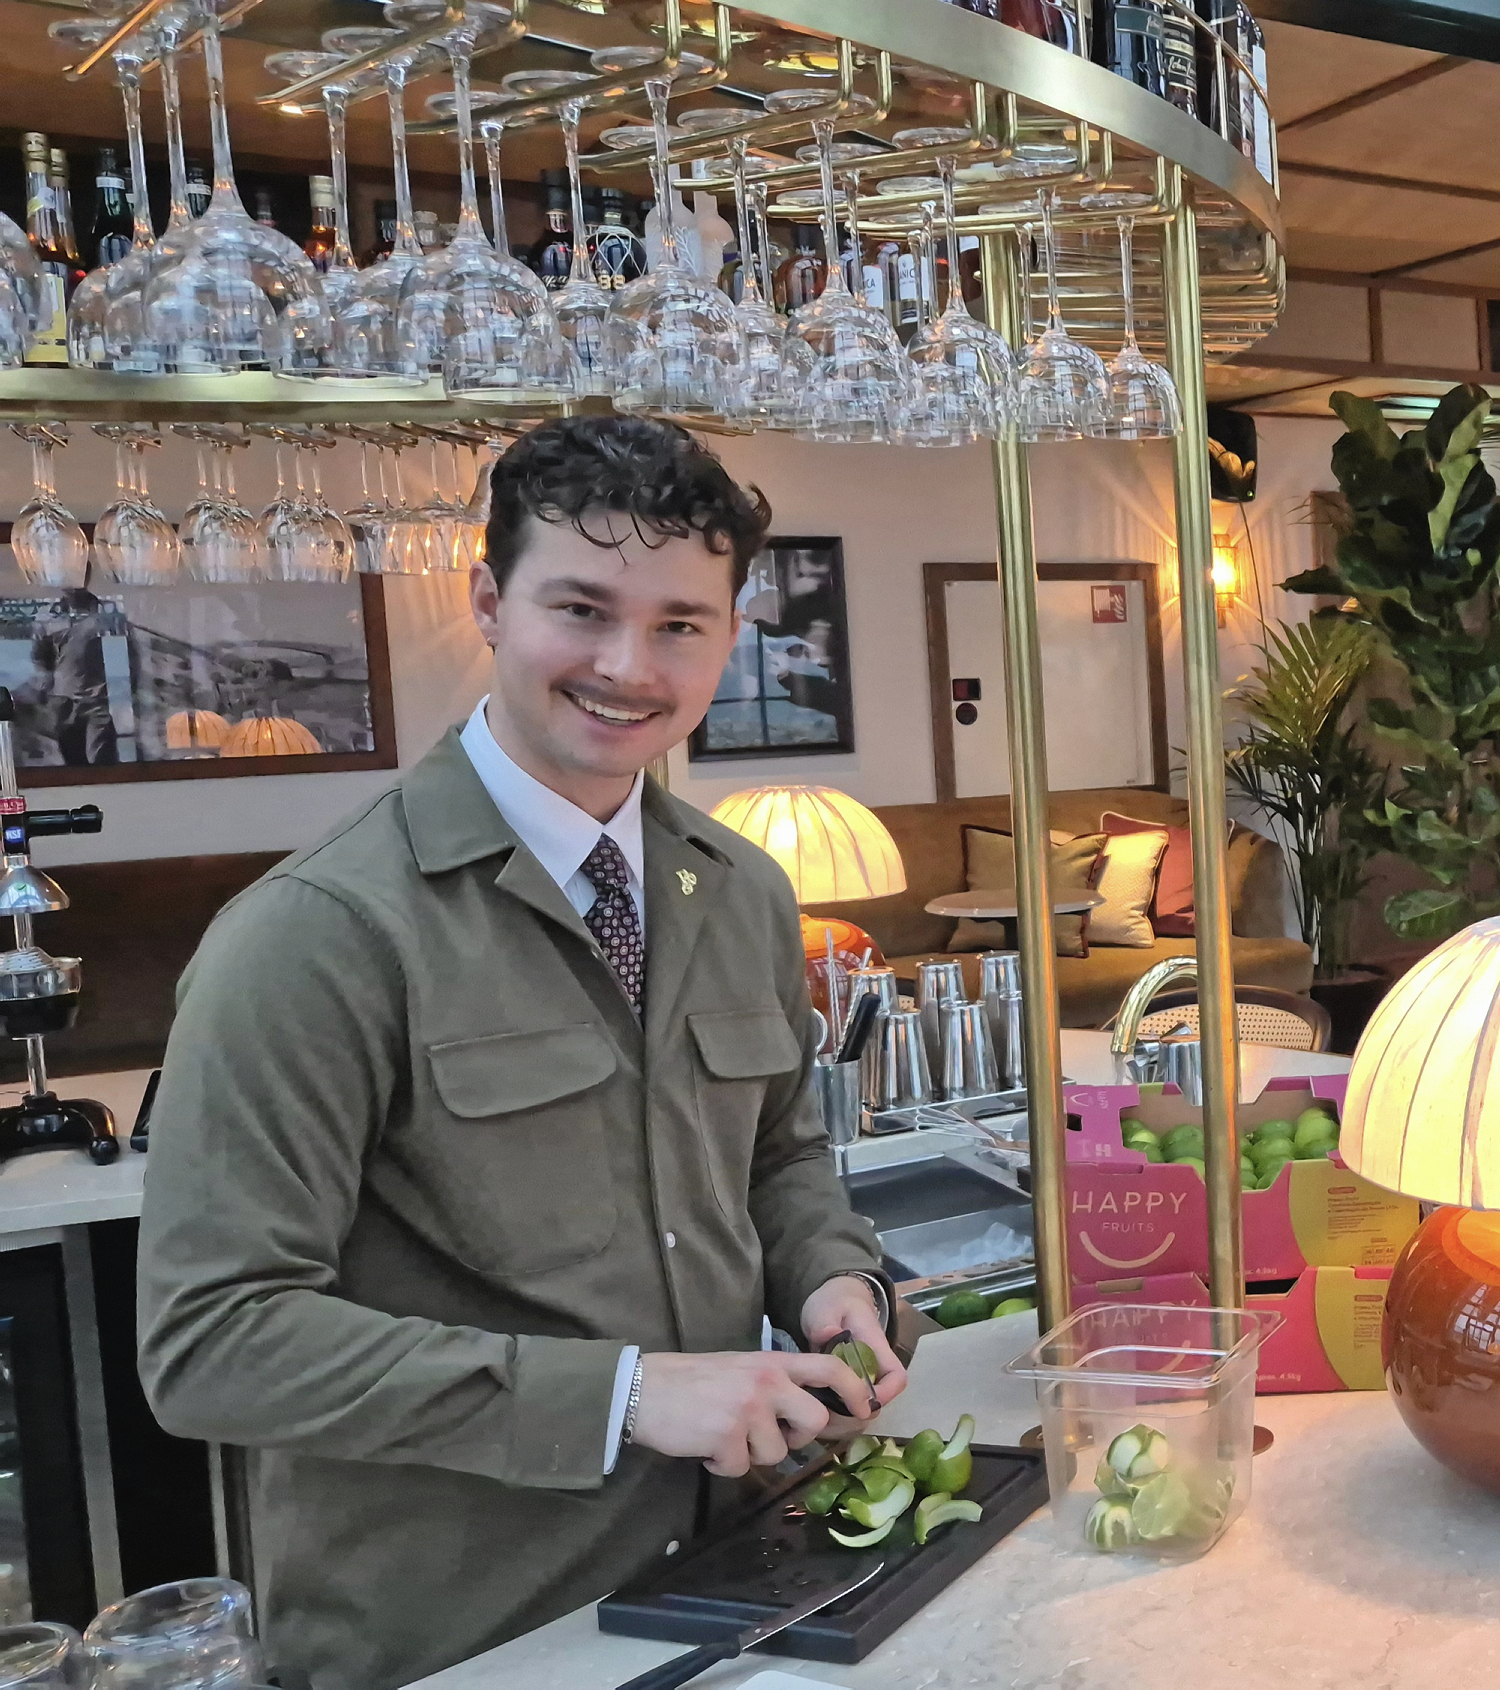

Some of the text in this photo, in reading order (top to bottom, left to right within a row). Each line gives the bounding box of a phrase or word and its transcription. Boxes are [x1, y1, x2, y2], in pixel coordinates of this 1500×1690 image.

[5, 828, 22, 840] NSF
[1072, 1190, 1187, 1215] HAPPY
[1102, 1222, 1155, 1233] FRUITS
